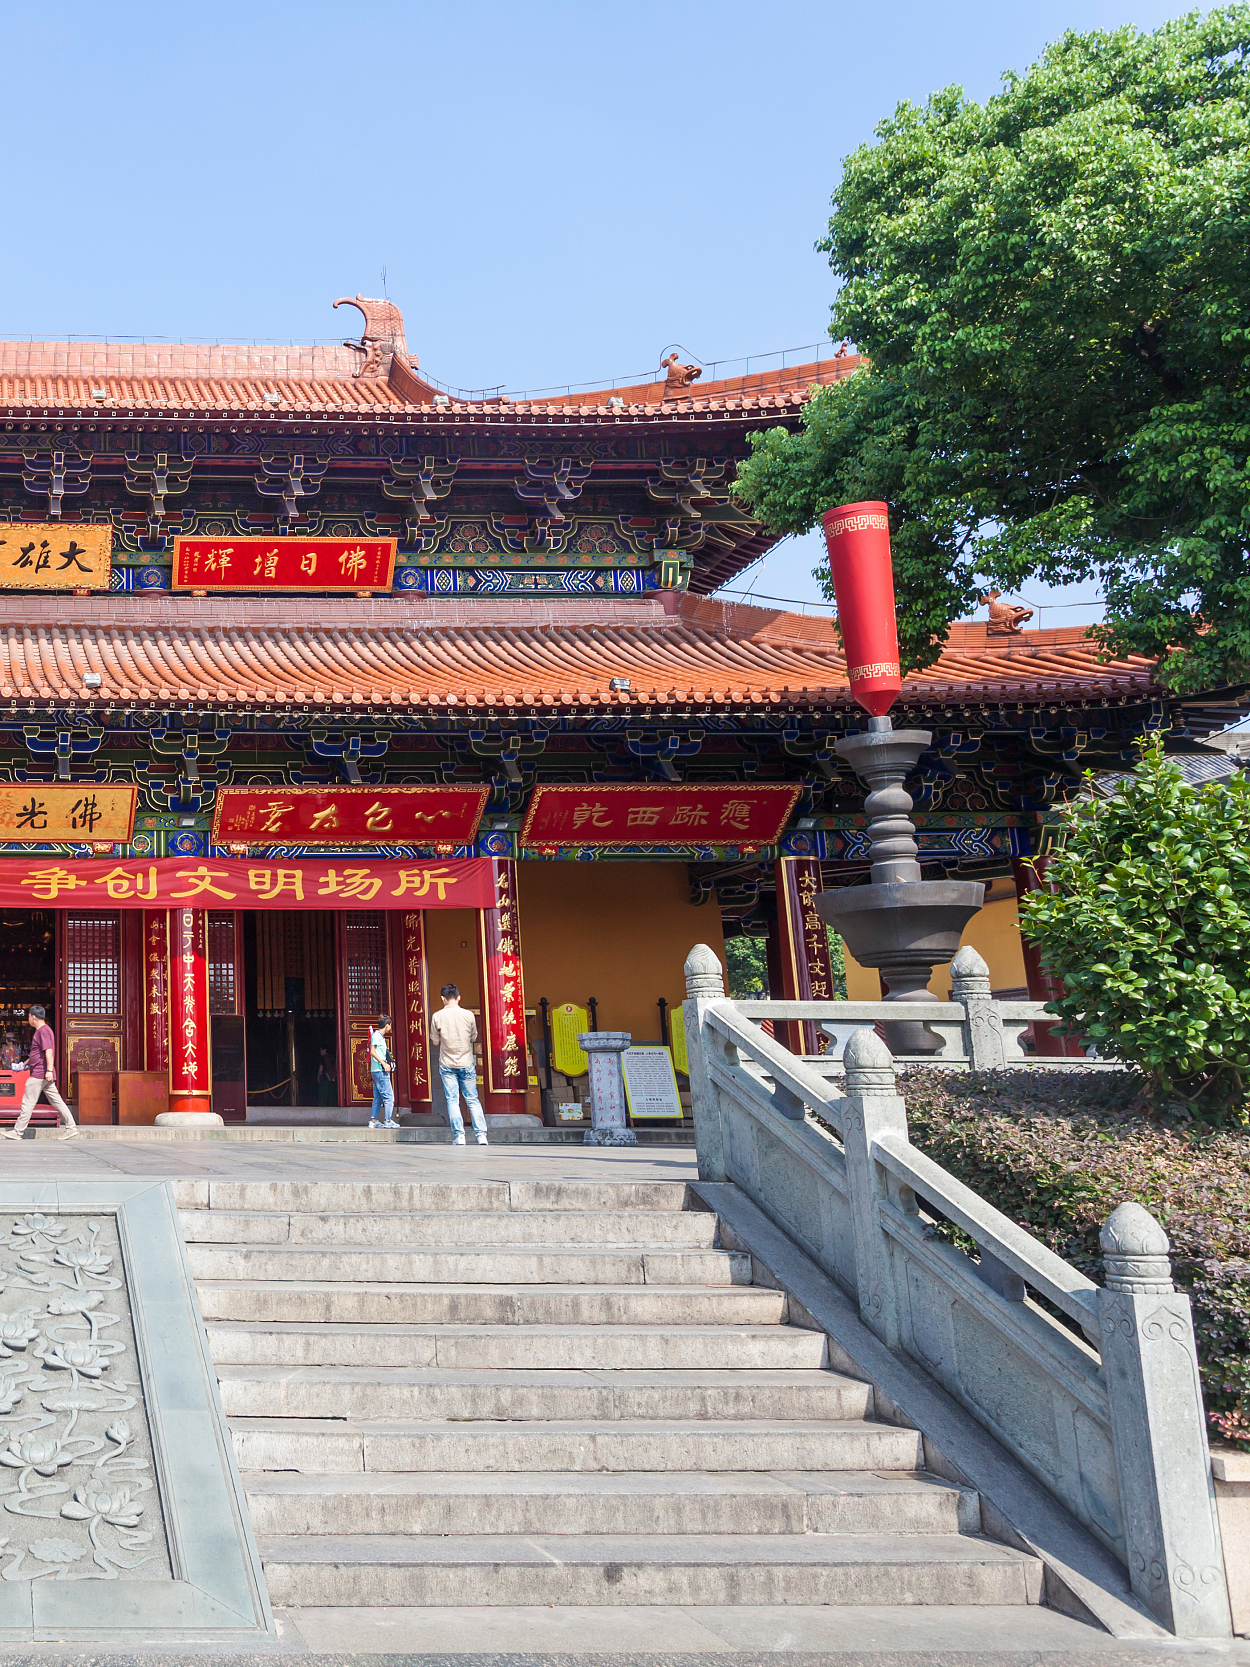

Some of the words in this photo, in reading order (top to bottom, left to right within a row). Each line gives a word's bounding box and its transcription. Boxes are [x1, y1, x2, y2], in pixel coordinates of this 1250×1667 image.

[204, 546, 368, 582] 佛日增輝
[20, 865, 458, 901] 争创文明场所
